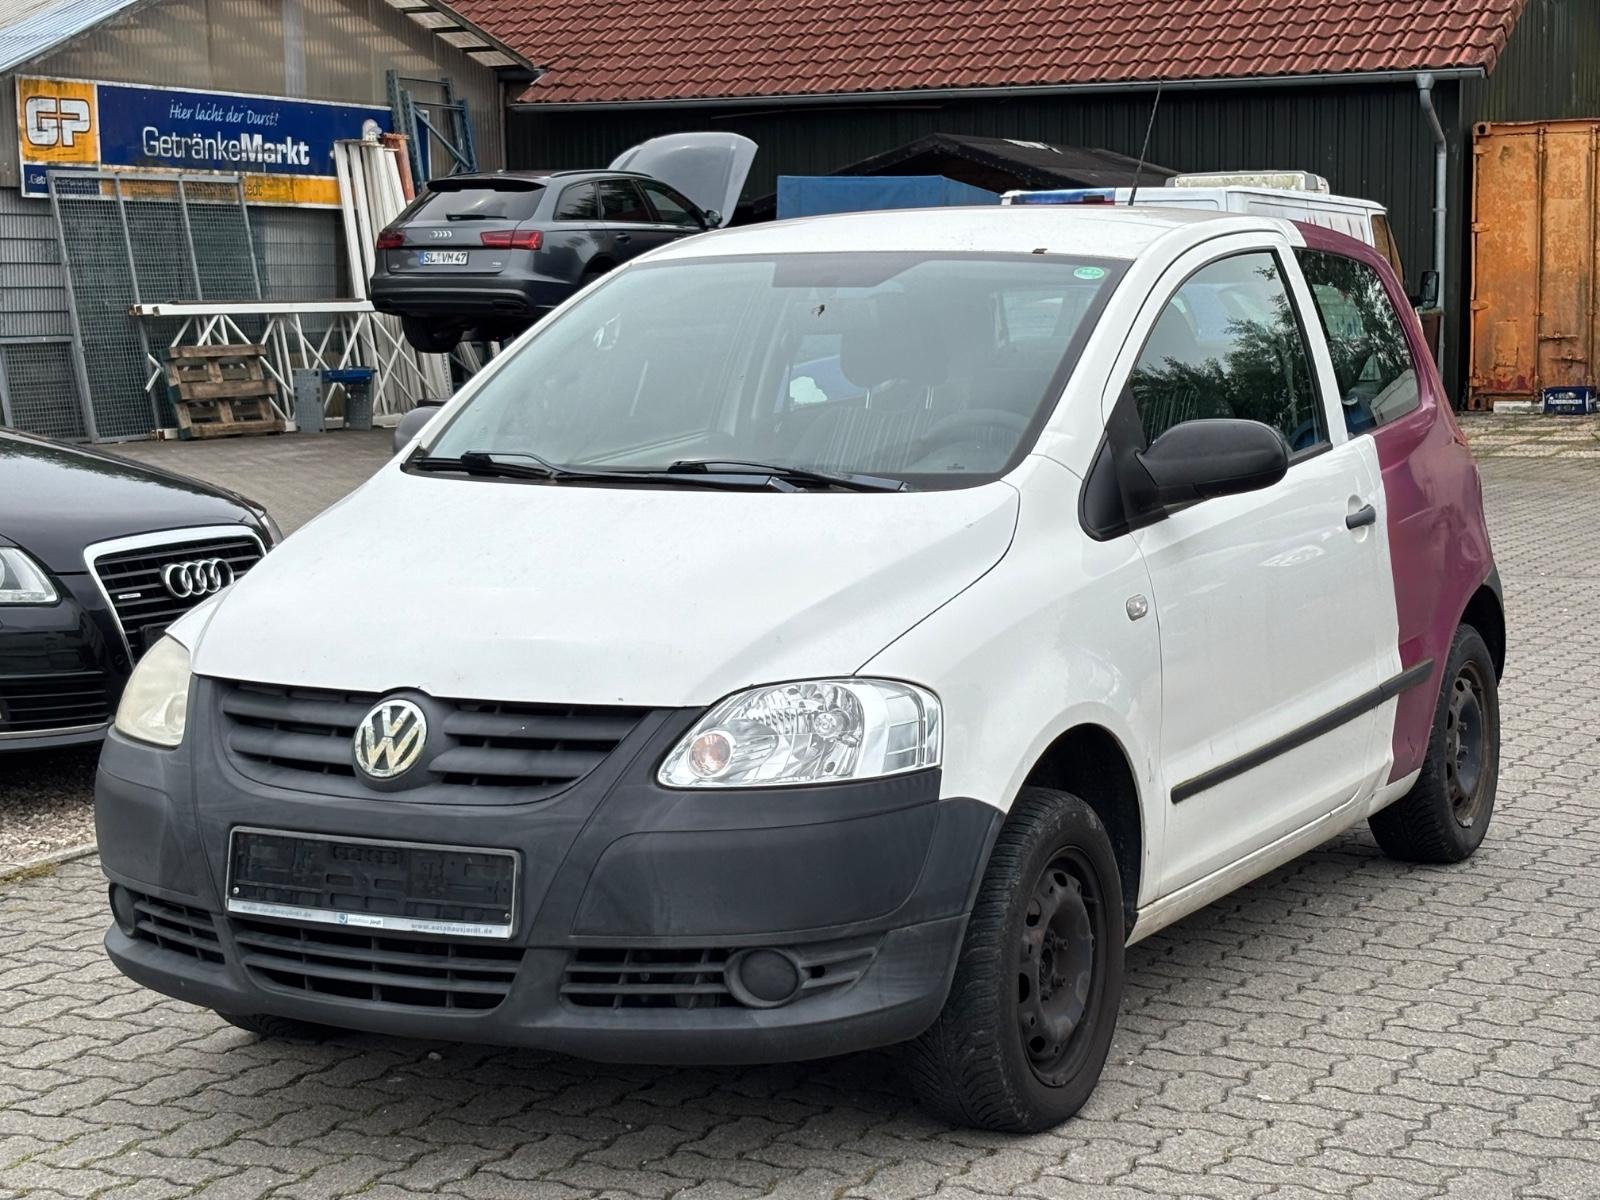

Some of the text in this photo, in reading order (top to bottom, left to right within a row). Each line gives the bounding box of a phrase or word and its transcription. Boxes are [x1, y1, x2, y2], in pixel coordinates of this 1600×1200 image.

[169, 102, 279, 126] Hier lacht der Durst!
[425, 252, 436, 263] SL
[455, 252, 467, 263] 47
